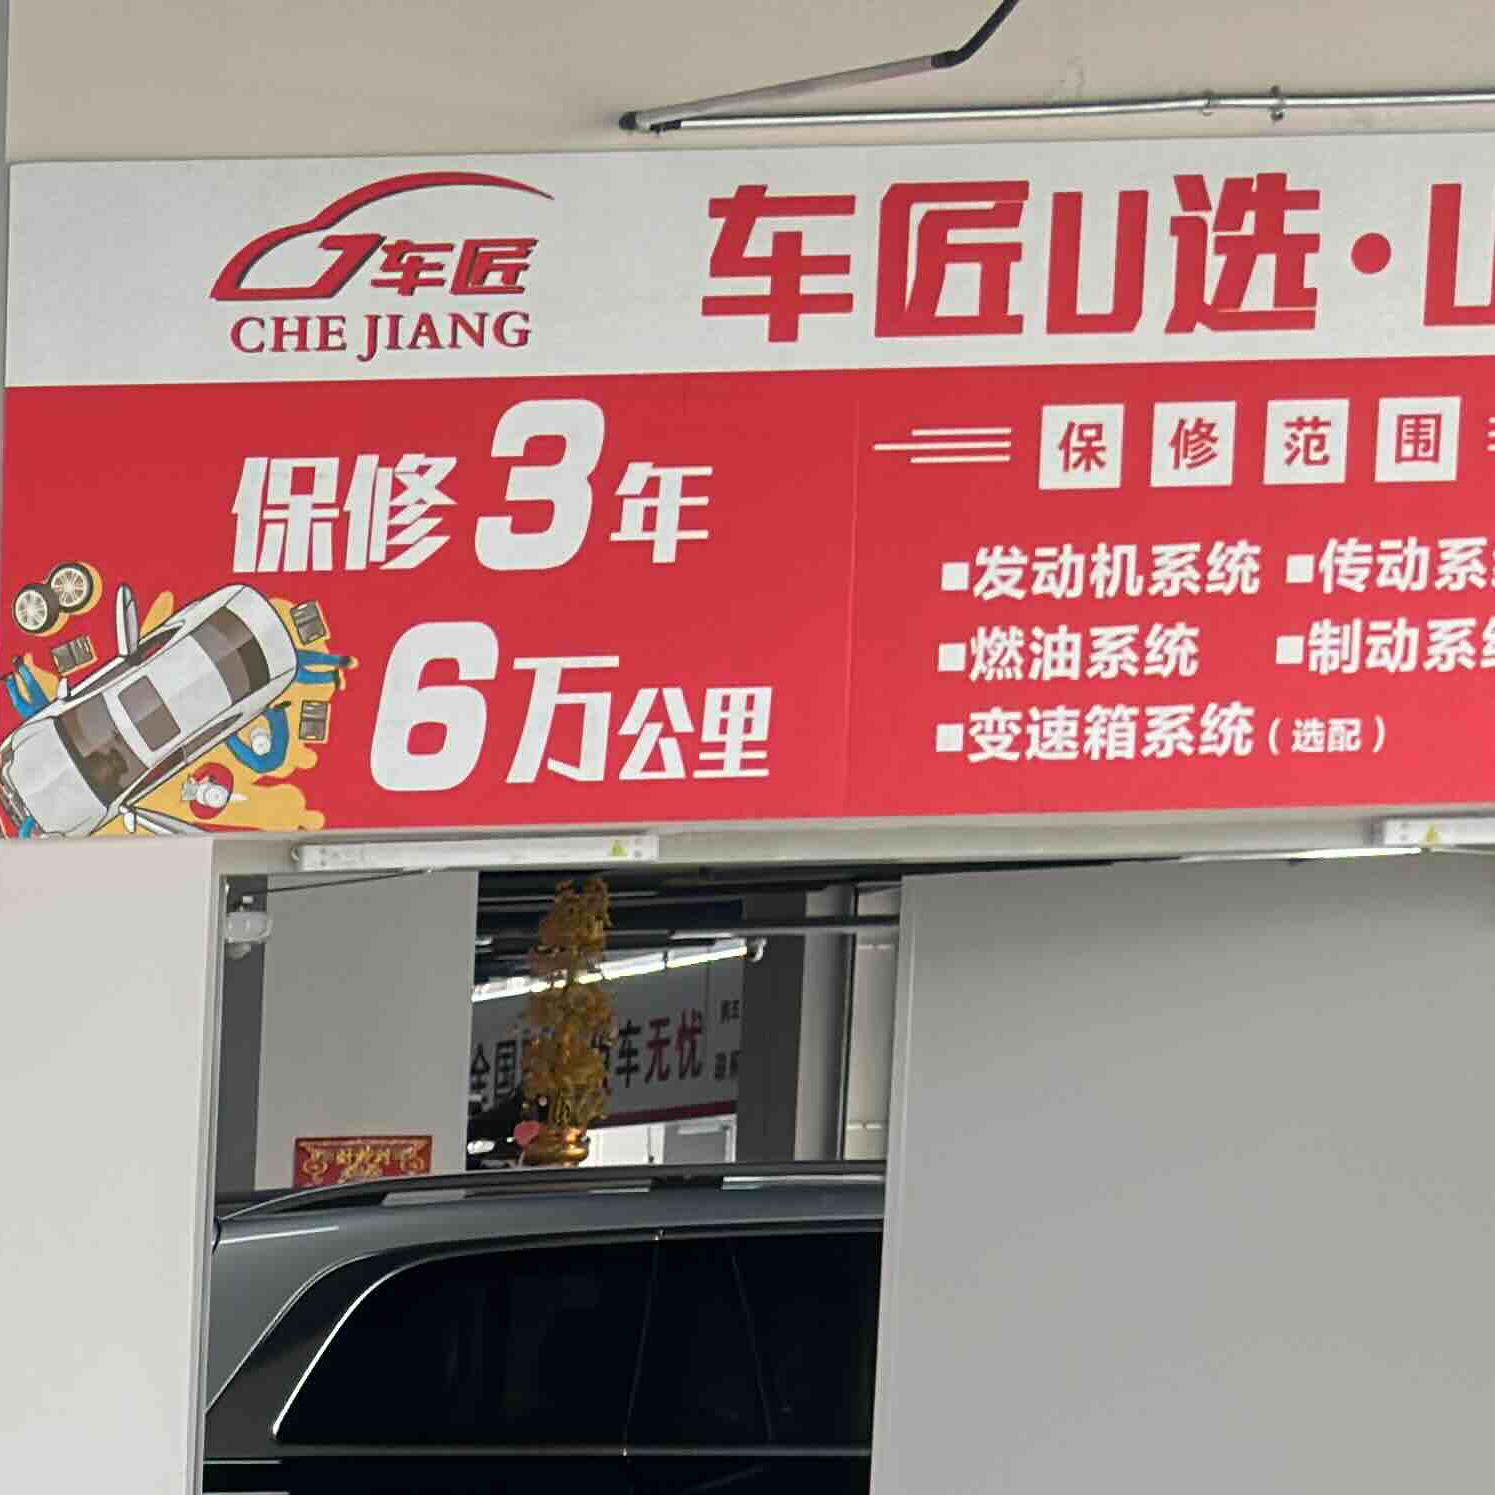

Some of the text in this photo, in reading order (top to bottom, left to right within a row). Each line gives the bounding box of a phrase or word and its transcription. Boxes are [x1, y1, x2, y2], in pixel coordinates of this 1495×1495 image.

[229, 310, 532, 363] CHE JIANG
[972, 535, 1495, 601] 发动机系统 传动系
[968, 621, 1201, 682] 燃油系统
[369, 620, 773, 793] 6万公里
[967, 700, 1256, 763] 变速箱系统
